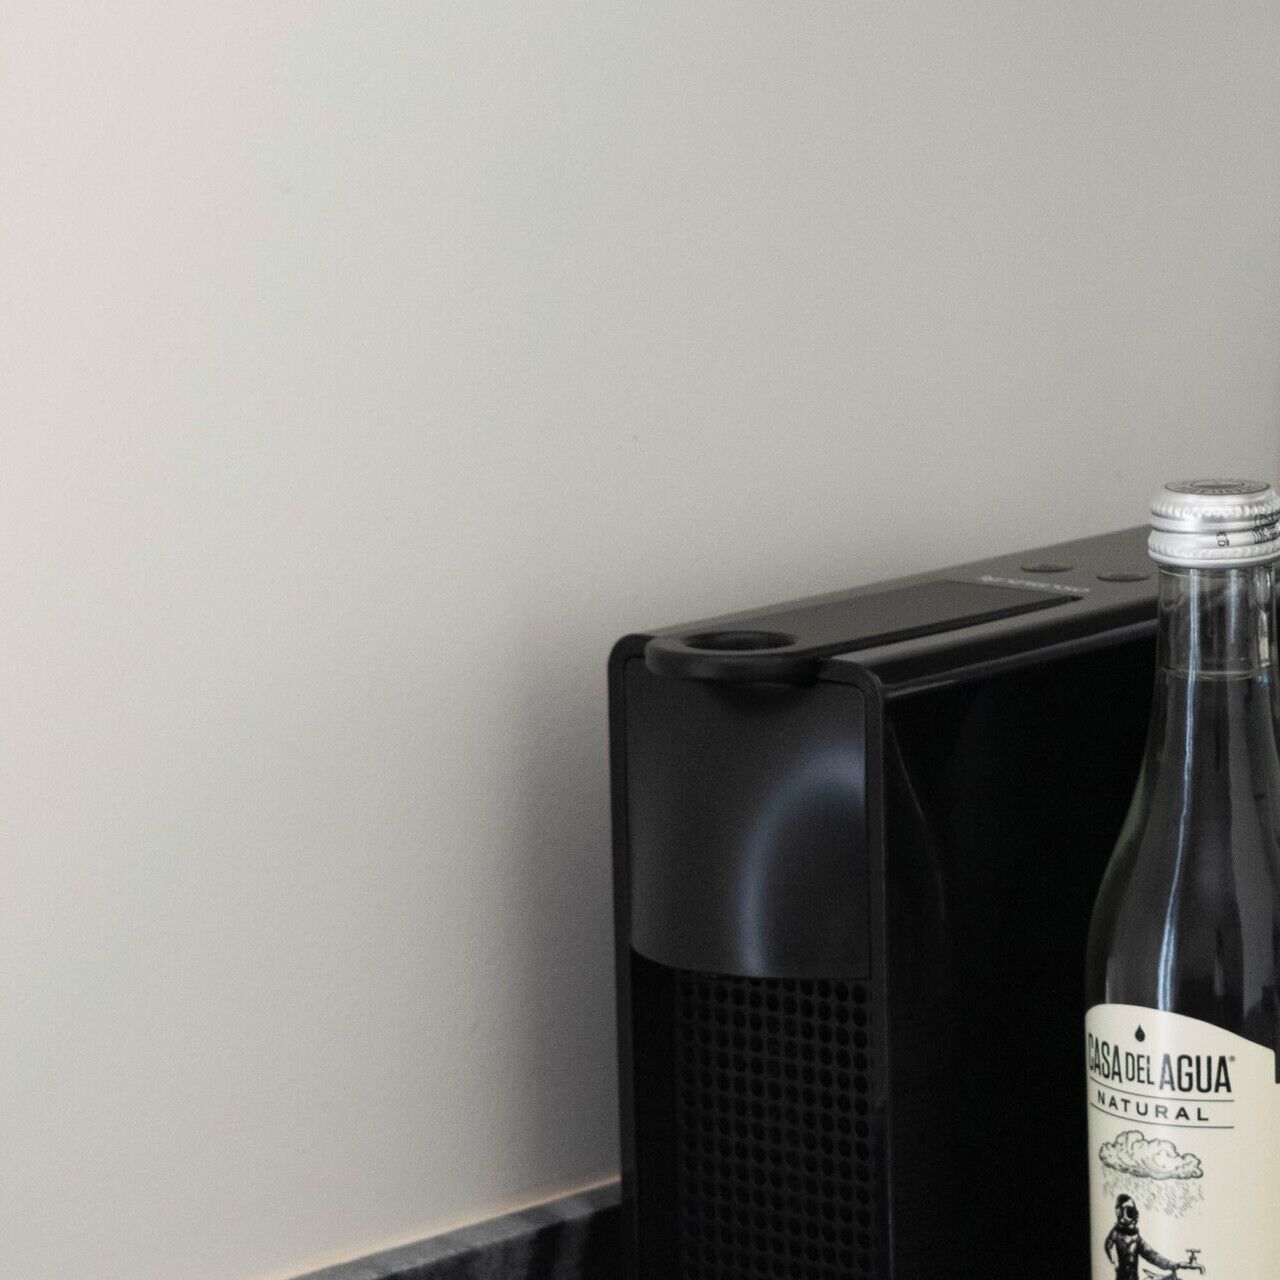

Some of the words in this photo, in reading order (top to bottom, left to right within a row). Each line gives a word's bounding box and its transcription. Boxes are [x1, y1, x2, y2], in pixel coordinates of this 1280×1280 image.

[1088, 1032, 1122, 1083] CASA
[1125, 1051, 1155, 1086] DEL
[1097, 1090, 1209, 1121] NATURAL
